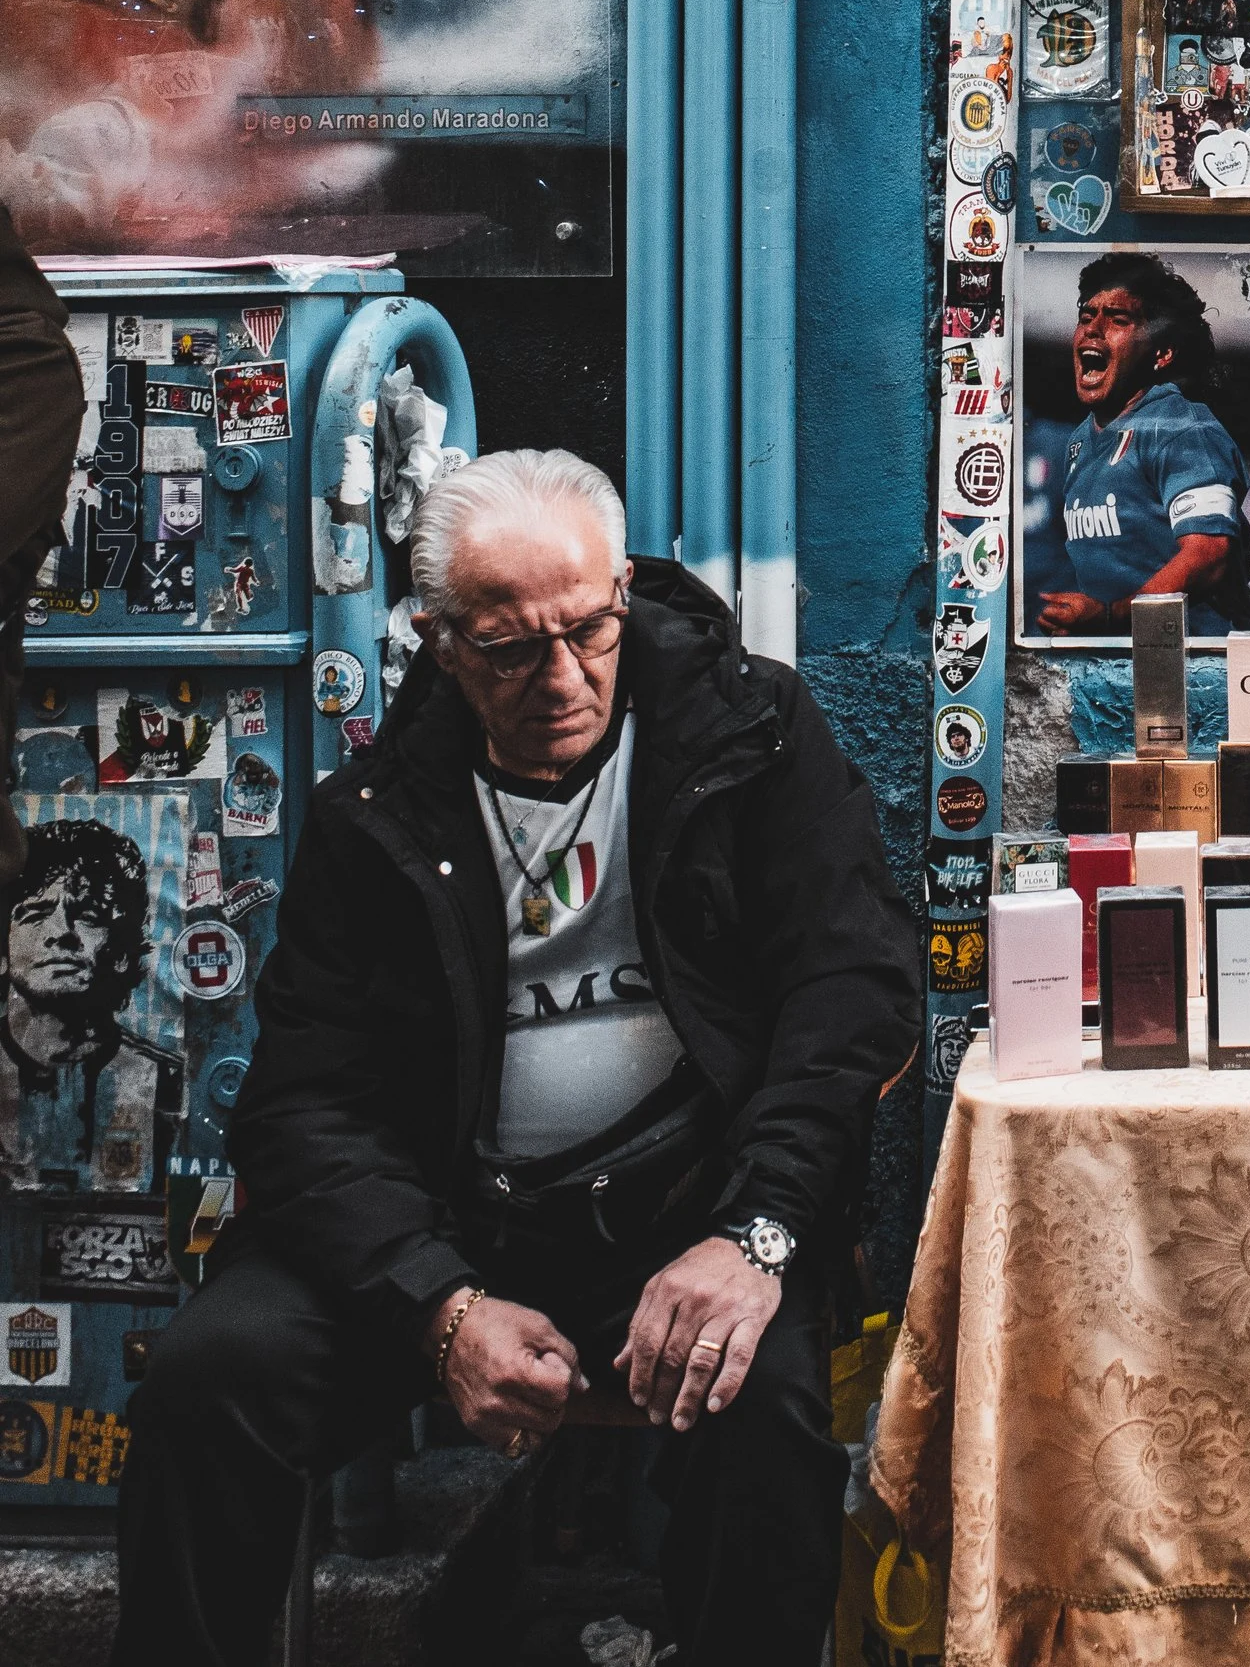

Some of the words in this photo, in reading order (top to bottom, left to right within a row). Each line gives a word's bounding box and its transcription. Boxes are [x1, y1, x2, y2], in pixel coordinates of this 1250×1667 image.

[973, 80, 994, 91] COMO
[244, 110, 312, 134] Diego
[318, 109, 426, 130] Armando
[432, 108, 551, 129] Maradona
[146, 387, 167, 411] CR
[190, 390, 213, 411] UG
[243, 718, 267, 734] FIEL
[942, 745, 983, 766] ARGENTINA
[946, 799, 975, 811] Manolo
[1168, 804, 1209, 812] MONTALE
[227, 808, 269, 825] BARNI
[1018, 869, 1055, 879] GUCCI
[1024, 878, 1050, 886] FLORA
[186, 953, 231, 967] OLGA
